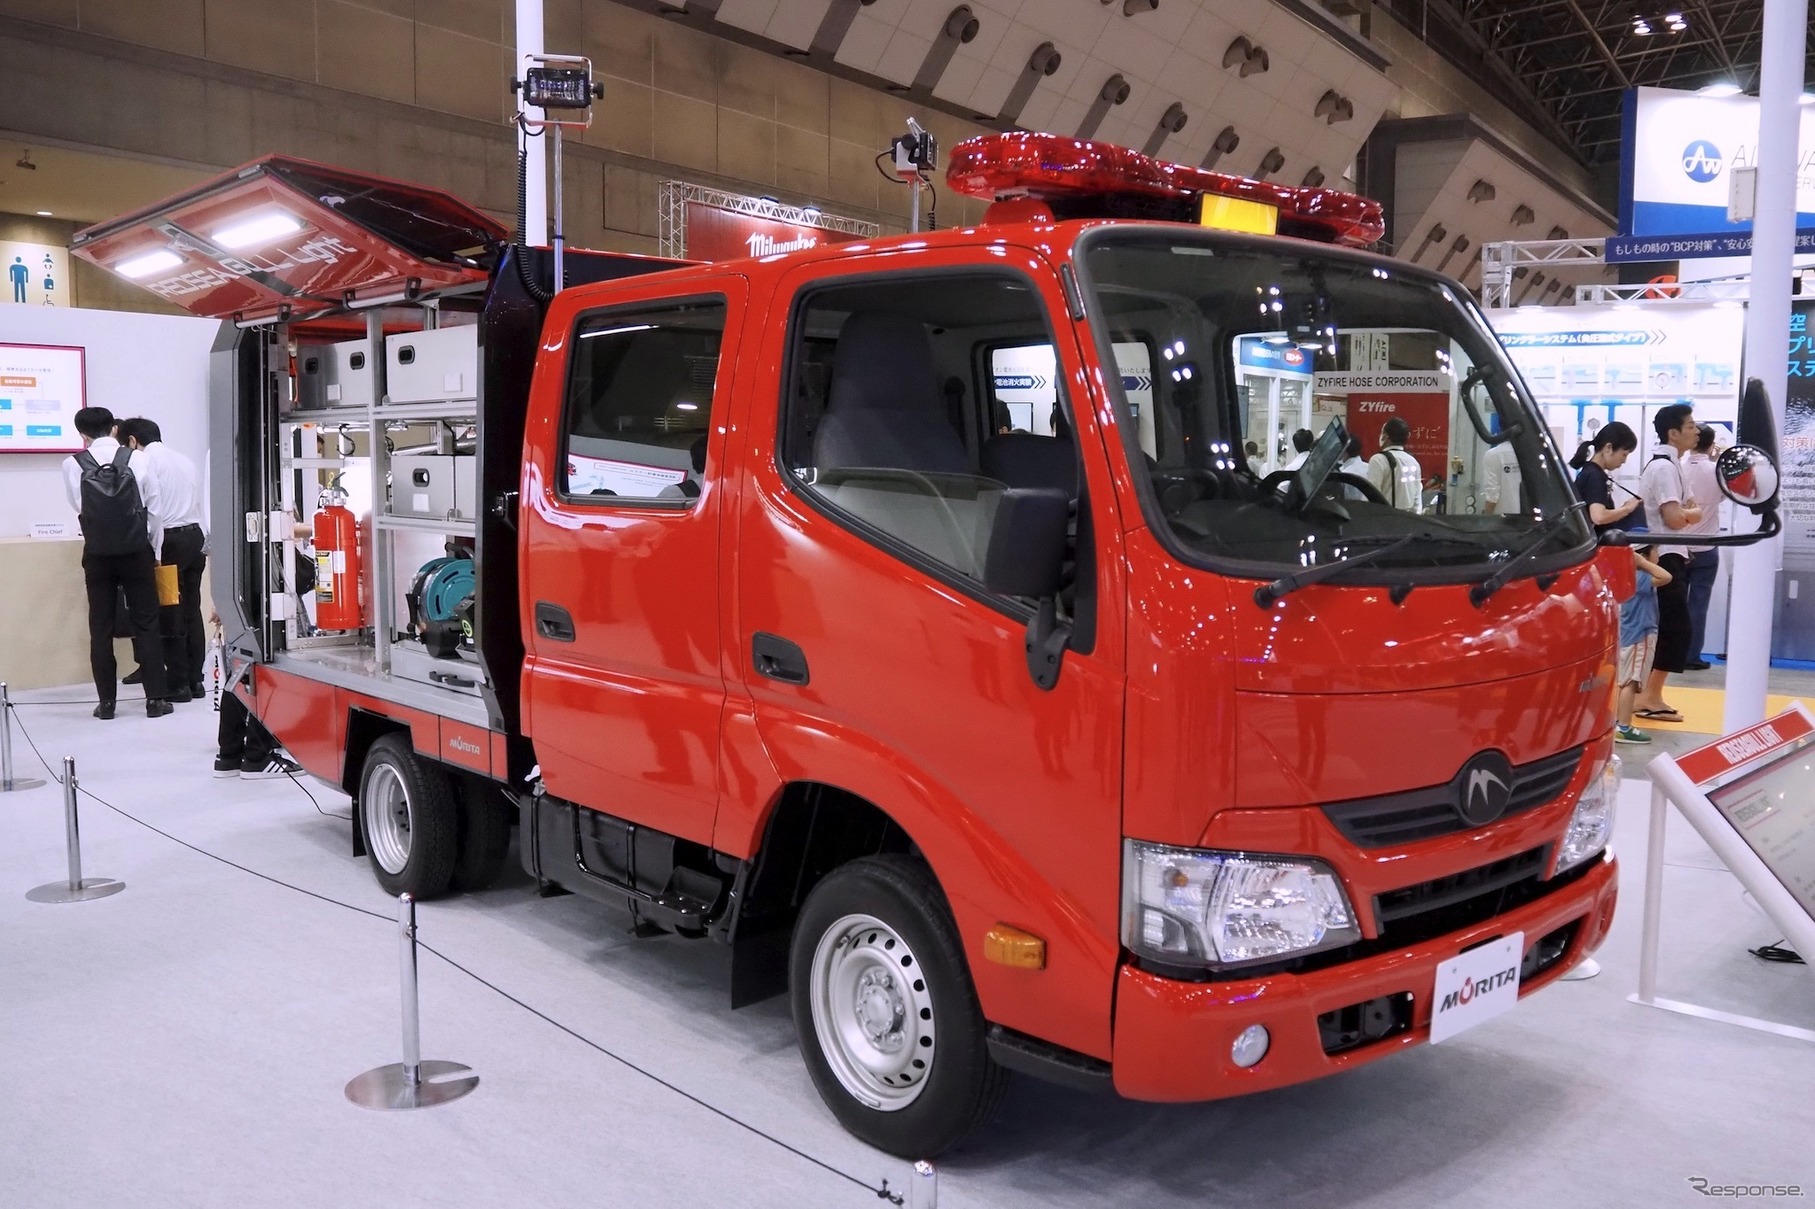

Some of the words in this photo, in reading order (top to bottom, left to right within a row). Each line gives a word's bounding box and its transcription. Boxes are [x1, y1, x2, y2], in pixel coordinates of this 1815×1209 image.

[1318, 377, 1347, 388] ZYFIRE
[1349, 377, 1373, 387] HOSE
[1375, 376, 1439, 387] CORPORATION
[1359, 401, 1396, 413] ZYfire
[1439, 965, 1517, 1014] MORITA
